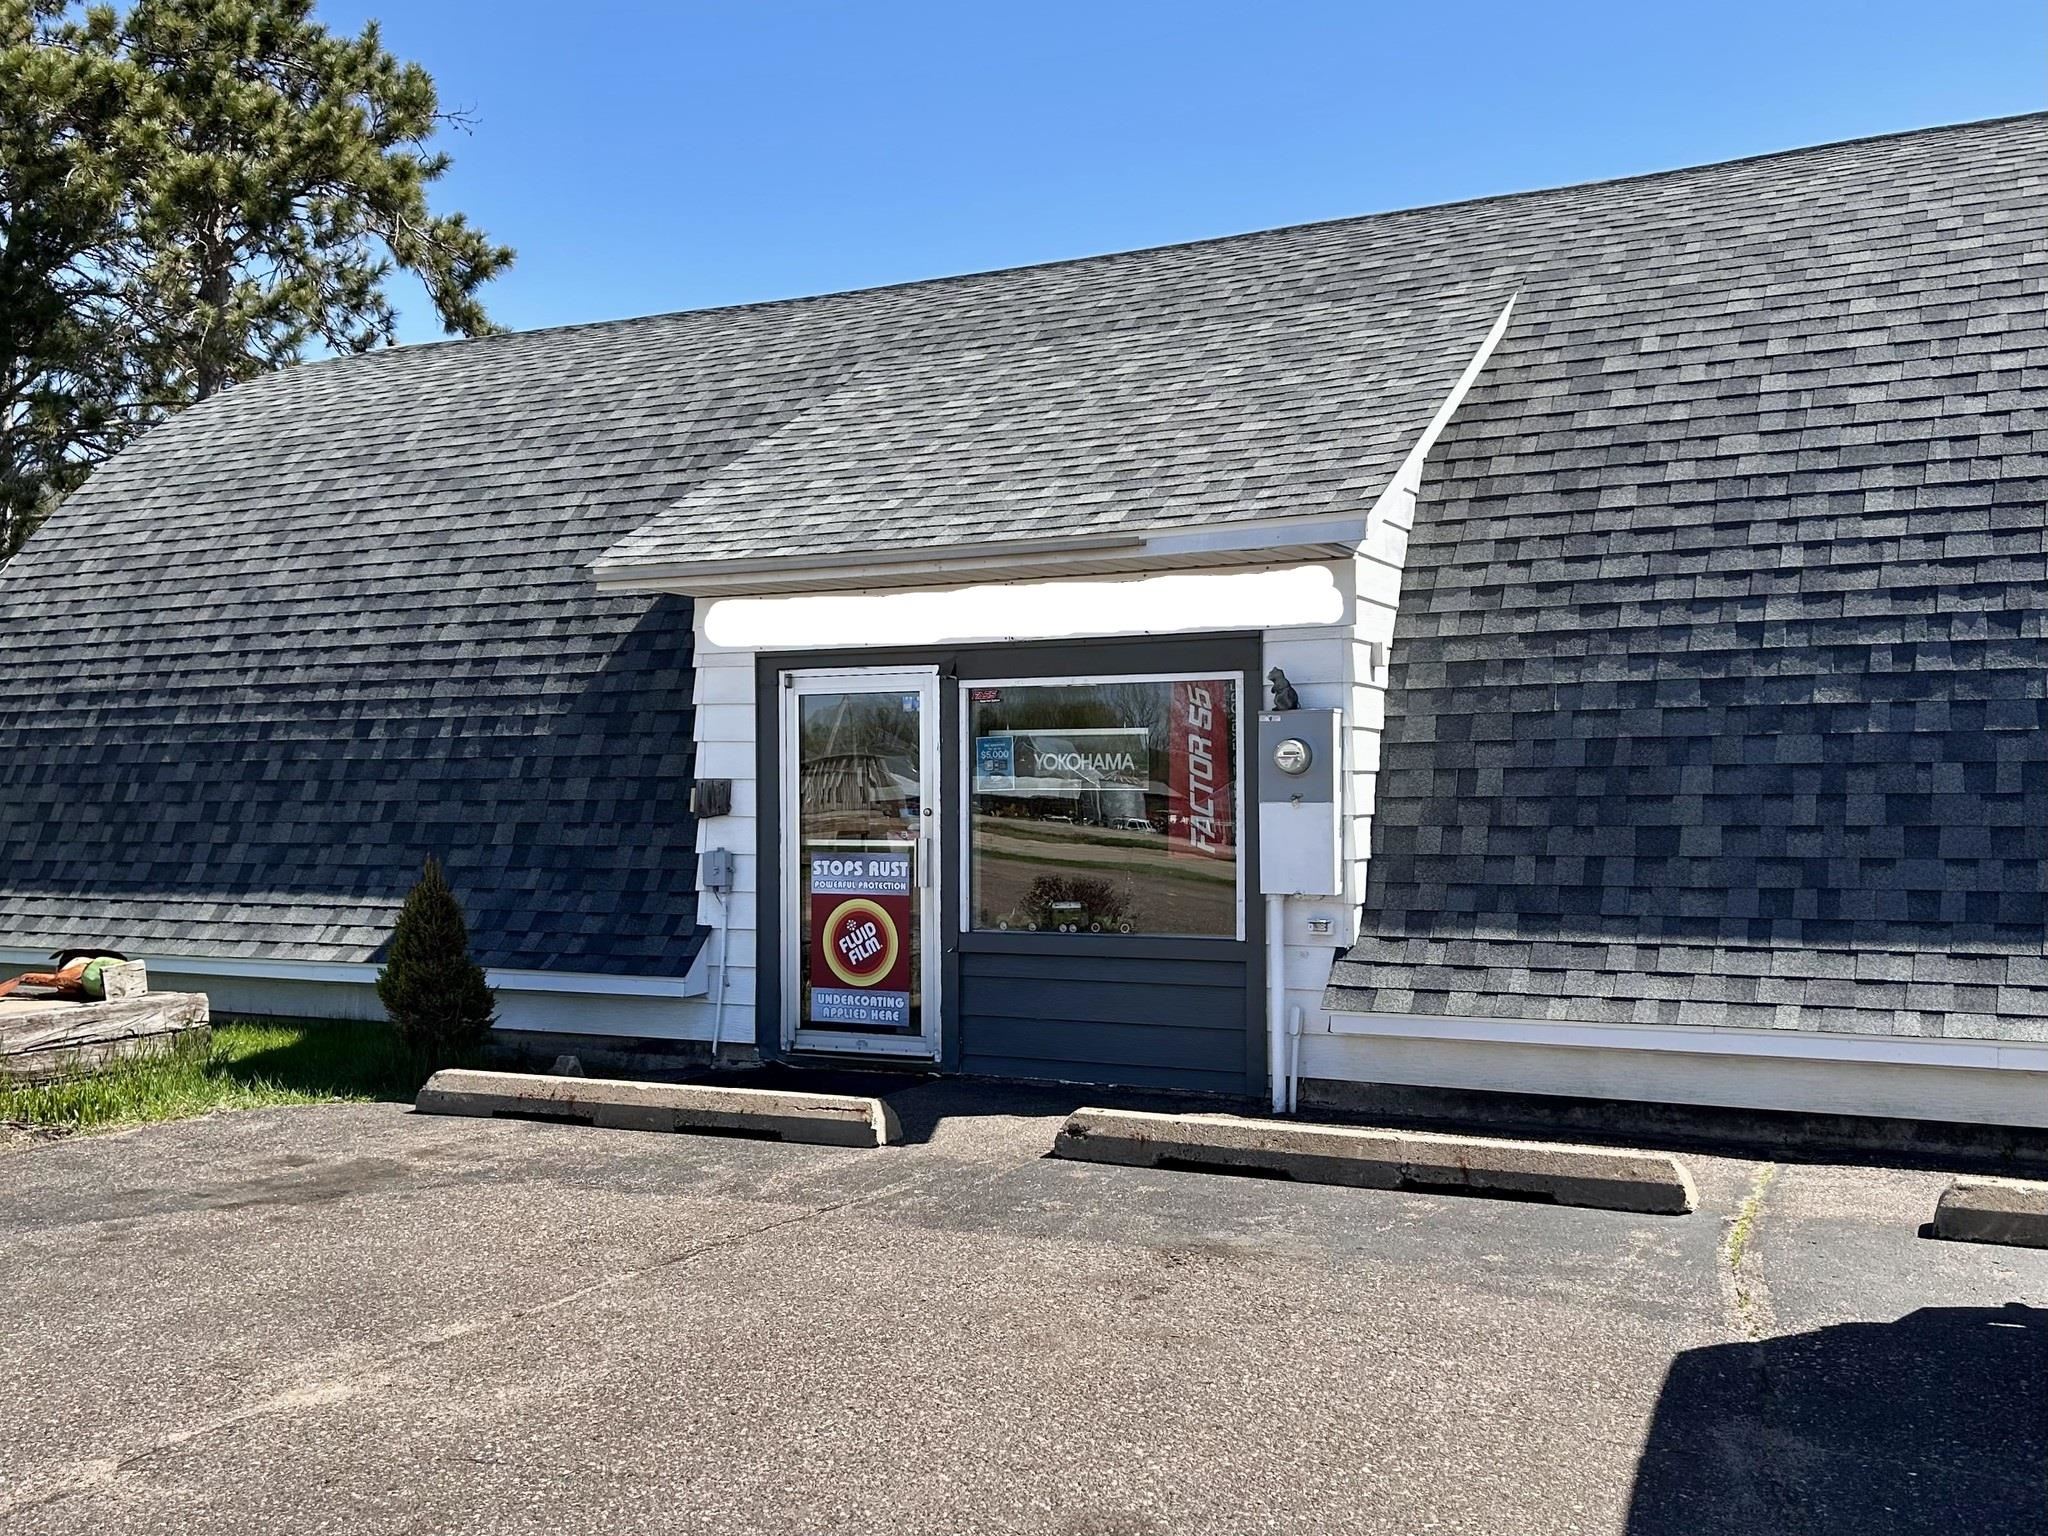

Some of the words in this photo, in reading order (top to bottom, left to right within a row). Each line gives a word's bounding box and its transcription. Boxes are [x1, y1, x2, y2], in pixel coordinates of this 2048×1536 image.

[1187, 684, 1213, 731] 55
[1034, 753, 1135, 770] YOKOHAMA
[1188, 733, 1215, 854] FACTOR
[813, 860, 863, 876] STOPS
[868, 861, 909, 877] RUST
[814, 881, 856, 889] POWERFUL
[858, 881, 907, 890] PROTECTION
[838, 921, 876, 954] FLUID
[848, 937, 881, 965] FILM
[817, 993, 905, 1008] UNDERCOATING
[823, 1007, 867, 1020] APPLIED
[871, 1009, 900, 1021] HERE
